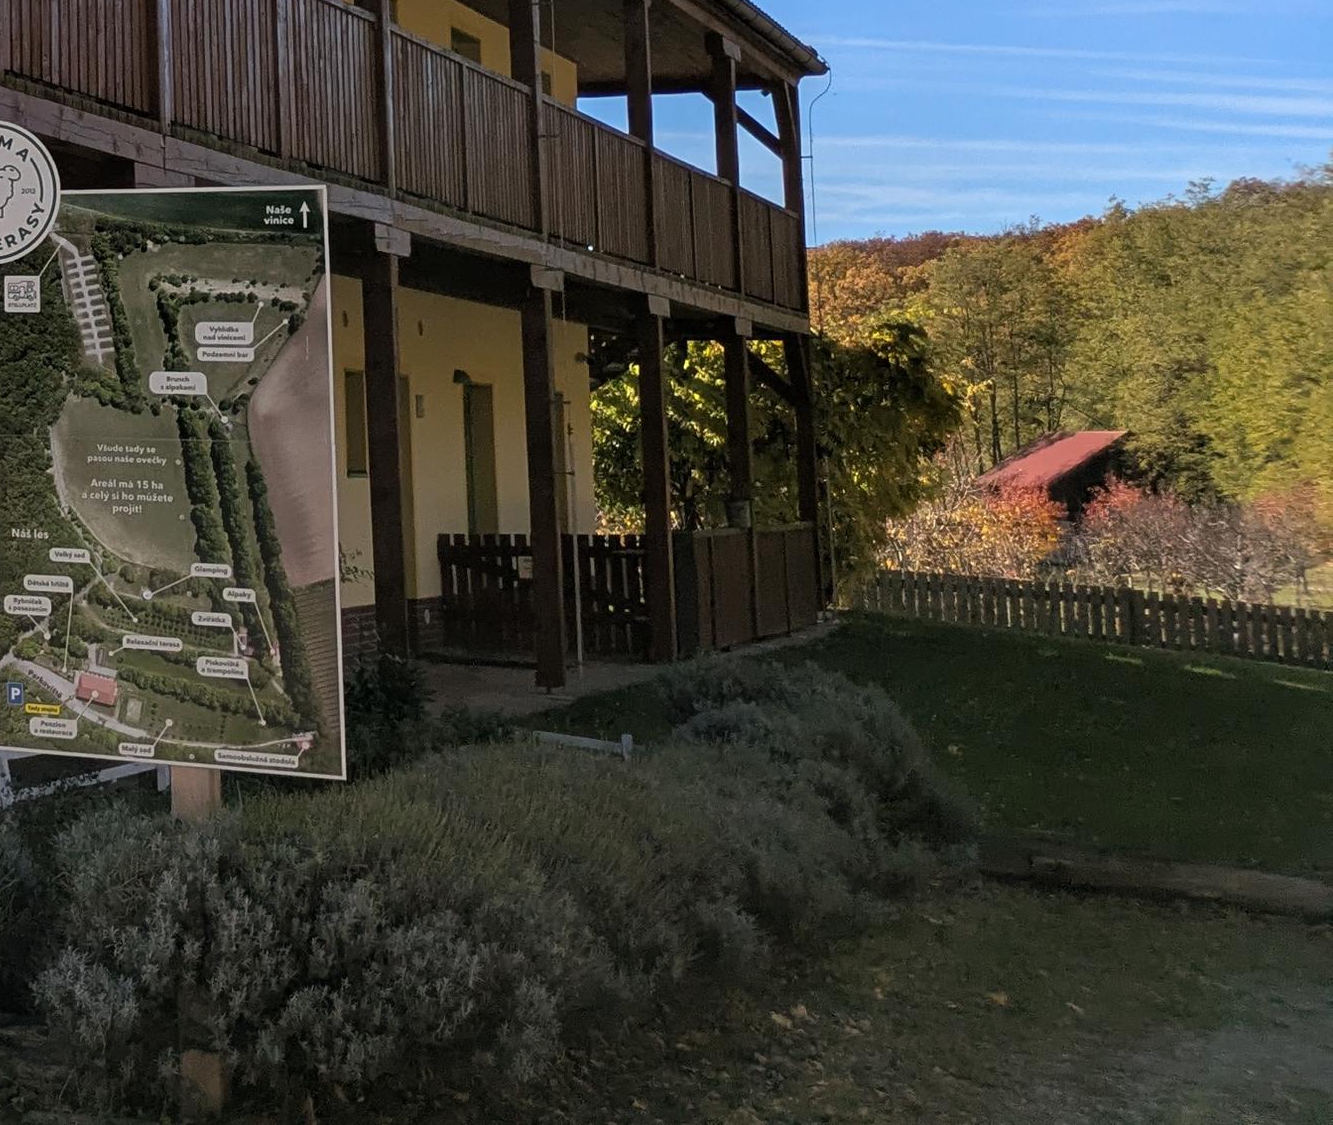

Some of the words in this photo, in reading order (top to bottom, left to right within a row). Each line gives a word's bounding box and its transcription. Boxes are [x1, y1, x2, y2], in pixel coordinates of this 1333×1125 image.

[266, 205, 292, 215] Naše
[263, 215, 295, 225] vinice
[97, 443, 124, 452] Všude
[125, 444, 145, 455] tady
[87, 455, 113, 463] pasou
[114, 455, 135, 463] naše
[136, 456, 167, 466] ovečky
[90, 478, 117, 488] Areál
[118, 480, 133, 489] má
[136, 480, 150, 489] 15
[151, 481, 164, 490] ha
[89, 491, 110, 502] celý
[111, 491, 119, 500] si
[121, 491, 135, 501] ho
[11, 528, 31, 539] Náš
[33, 529, 49, 540] les
[194, 565, 228, 575] Glamping
[10, 687, 21, 700] P
